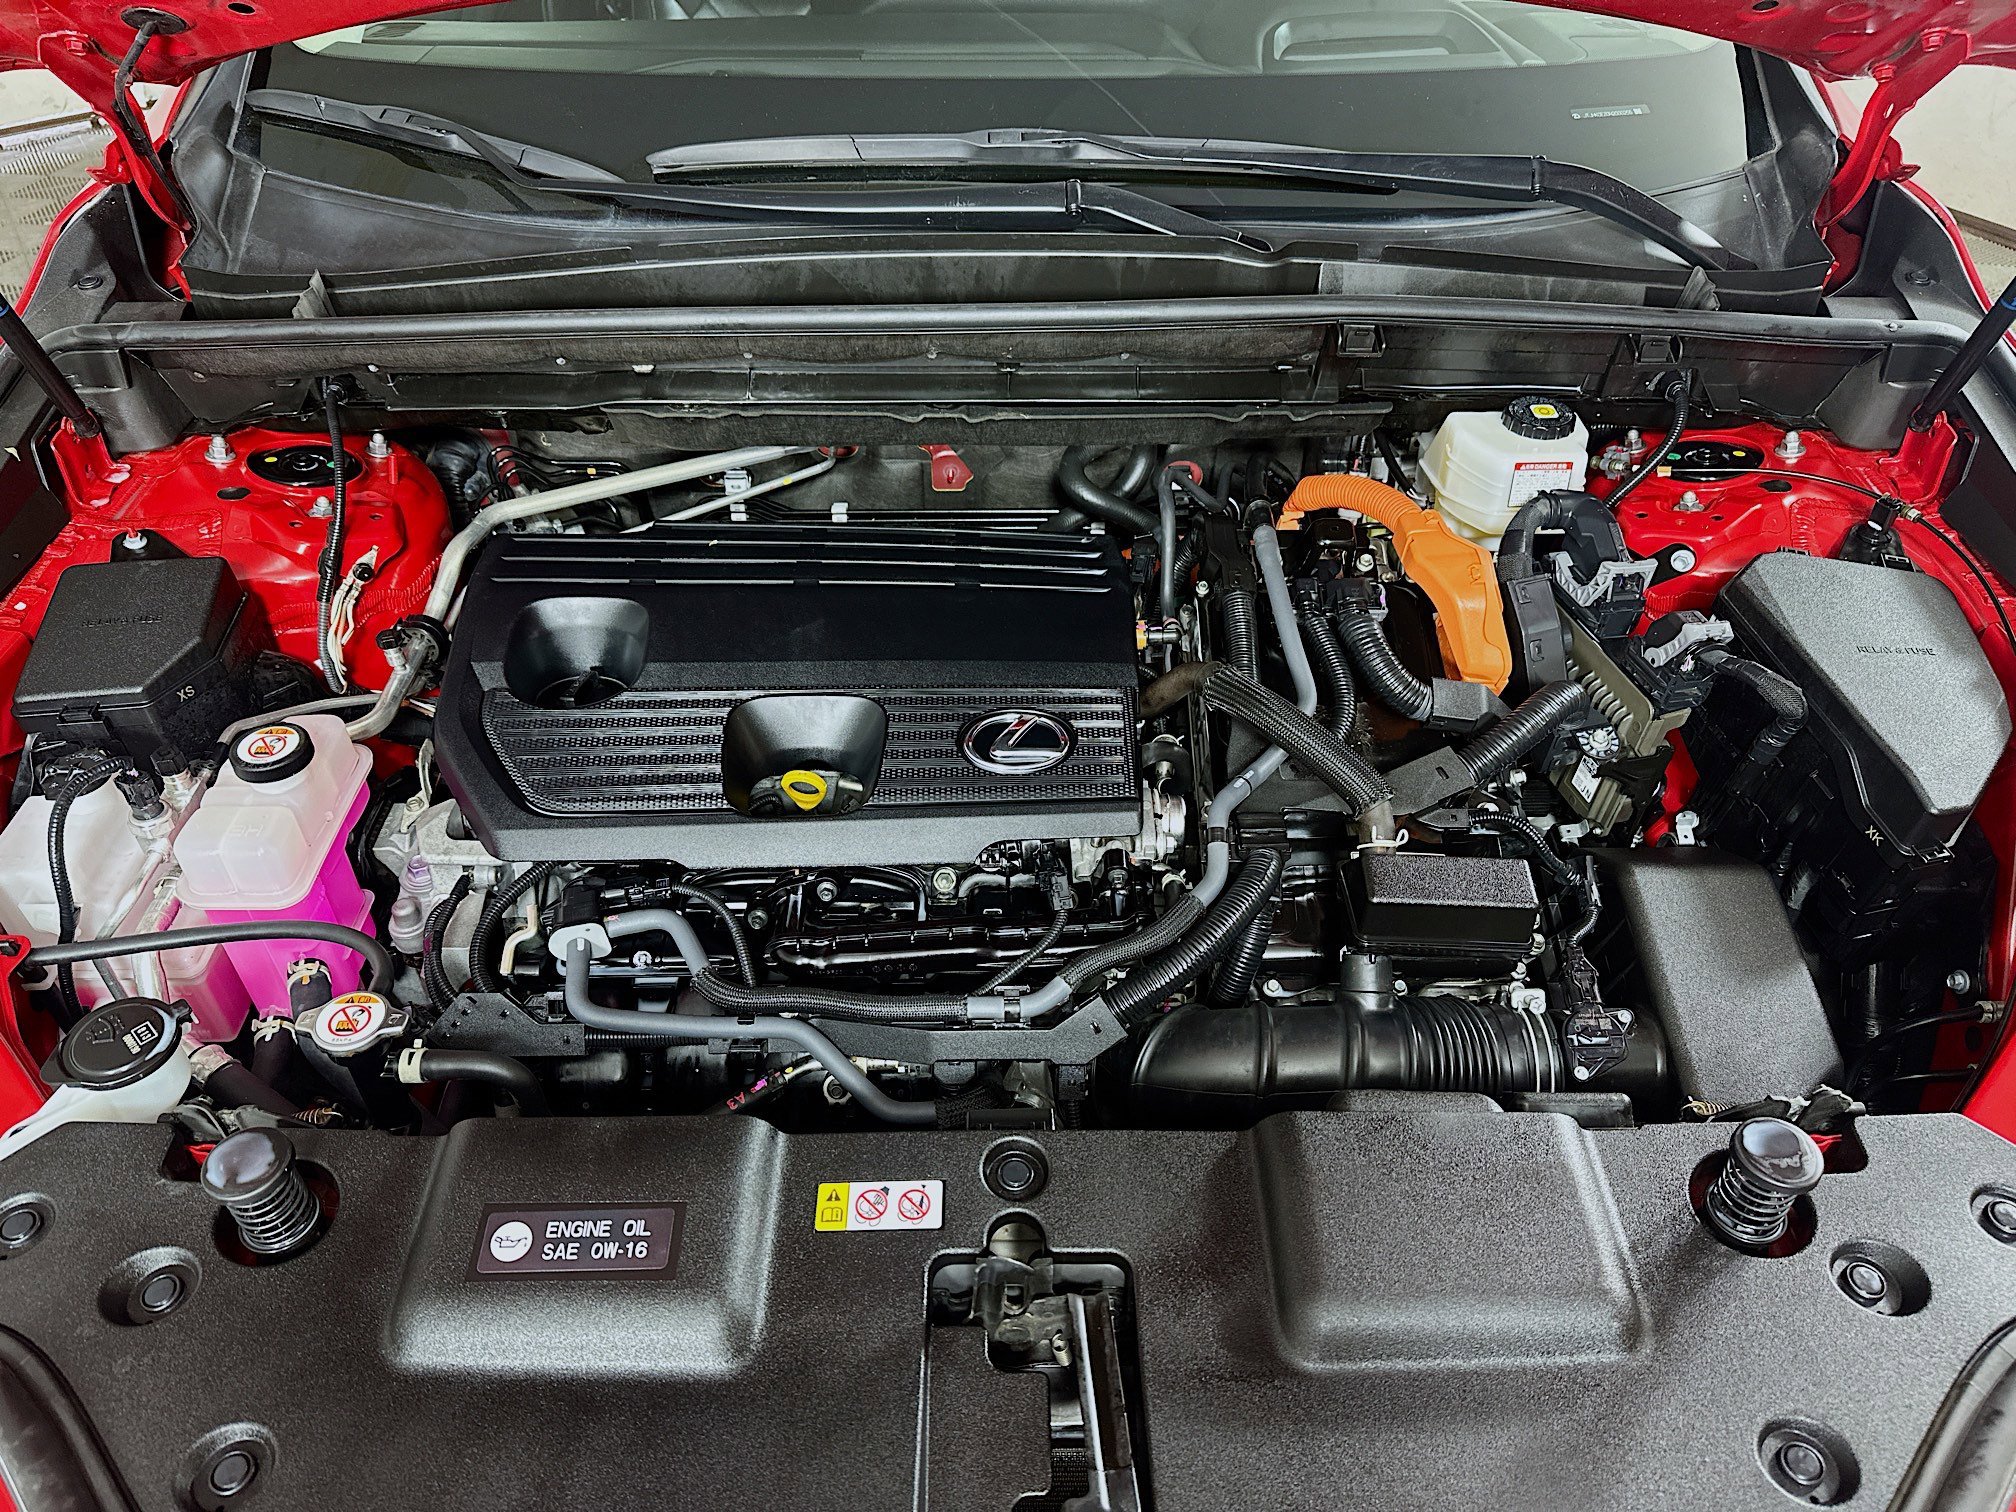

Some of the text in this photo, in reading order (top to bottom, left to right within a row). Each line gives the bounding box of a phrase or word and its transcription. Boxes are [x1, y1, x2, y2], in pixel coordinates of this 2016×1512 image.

[1856, 645, 1893, 654] RELAY
[1904, 646, 1937, 656] FUSE
[176, 685, 195, 702] XS
[1865, 824, 1884, 847] XK
[545, 1219, 652, 1239] ENGINE OIL
[541, 1241, 649, 1261] SAE 0W-16
